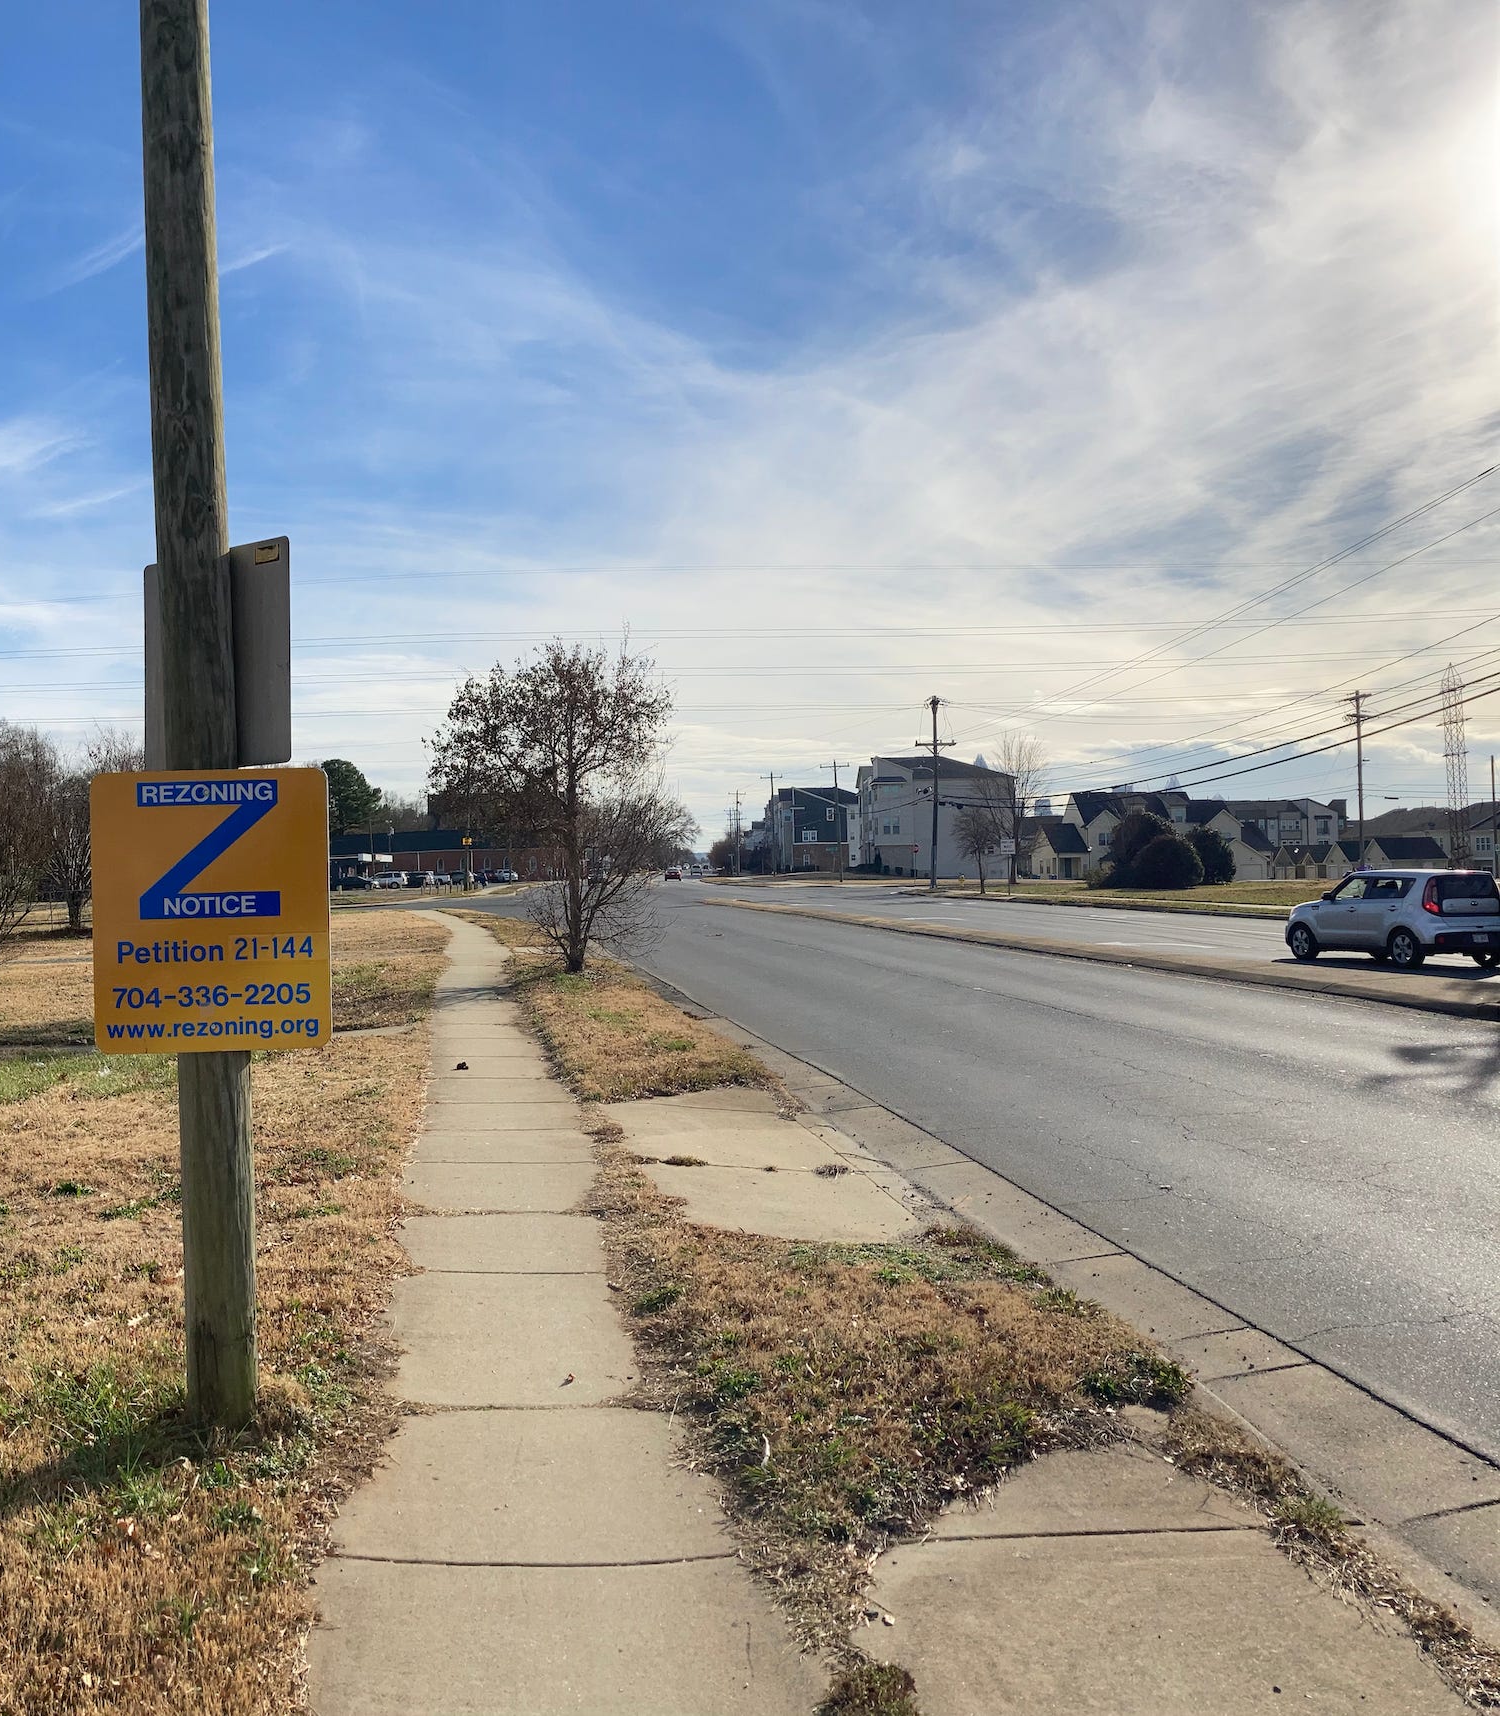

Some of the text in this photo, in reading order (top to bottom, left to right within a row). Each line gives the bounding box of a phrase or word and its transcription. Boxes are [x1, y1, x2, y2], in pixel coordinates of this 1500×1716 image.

[141, 782, 273, 803] REZONING
[163, 895, 257, 915] NOTICE
[117, 935, 313, 964] Petition 21-144
[112, 983, 311, 1009] 704-336-2205
[106, 1016, 319, 1039] www.rezoning.org
